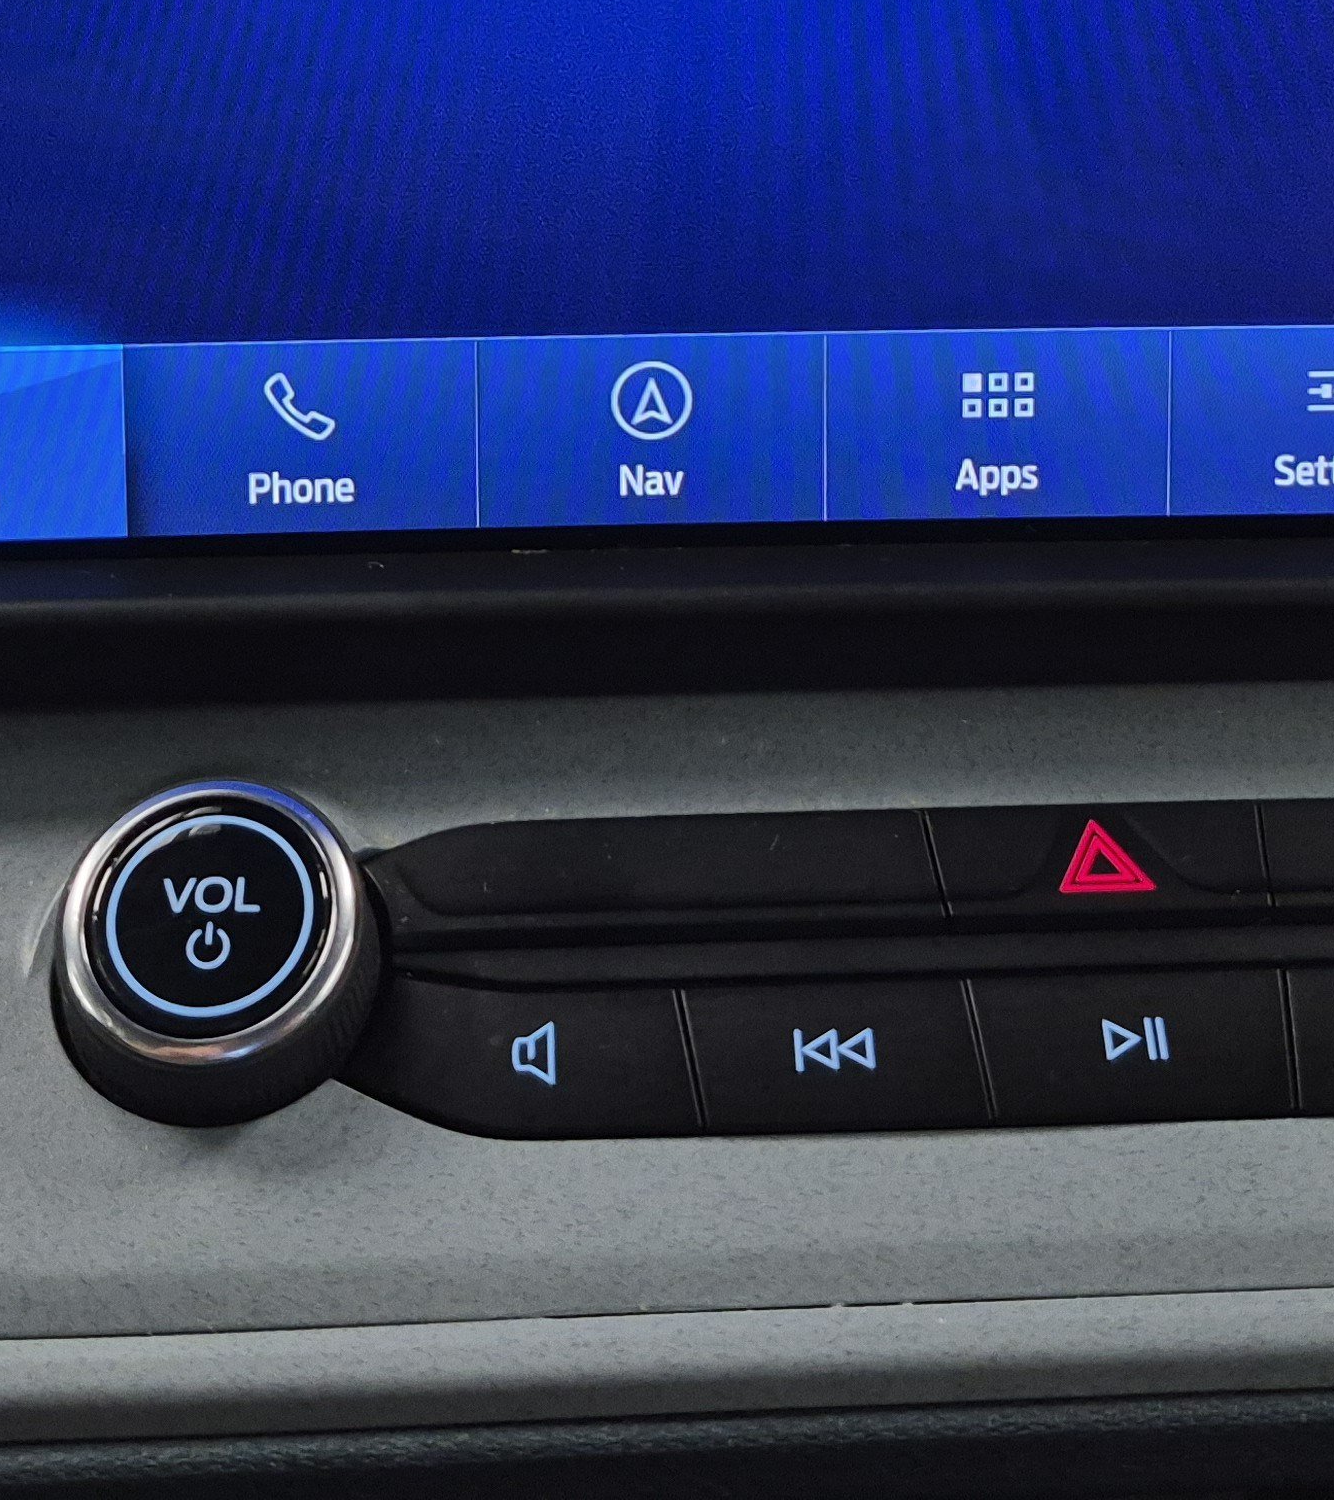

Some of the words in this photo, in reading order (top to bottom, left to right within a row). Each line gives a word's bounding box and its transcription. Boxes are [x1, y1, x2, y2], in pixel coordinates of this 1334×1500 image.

[248, 471, 355, 505] Phone
[619, 464, 685, 497] Nav
[955, 458, 1039, 496] Apps
[163, 876, 261, 914] VOL
